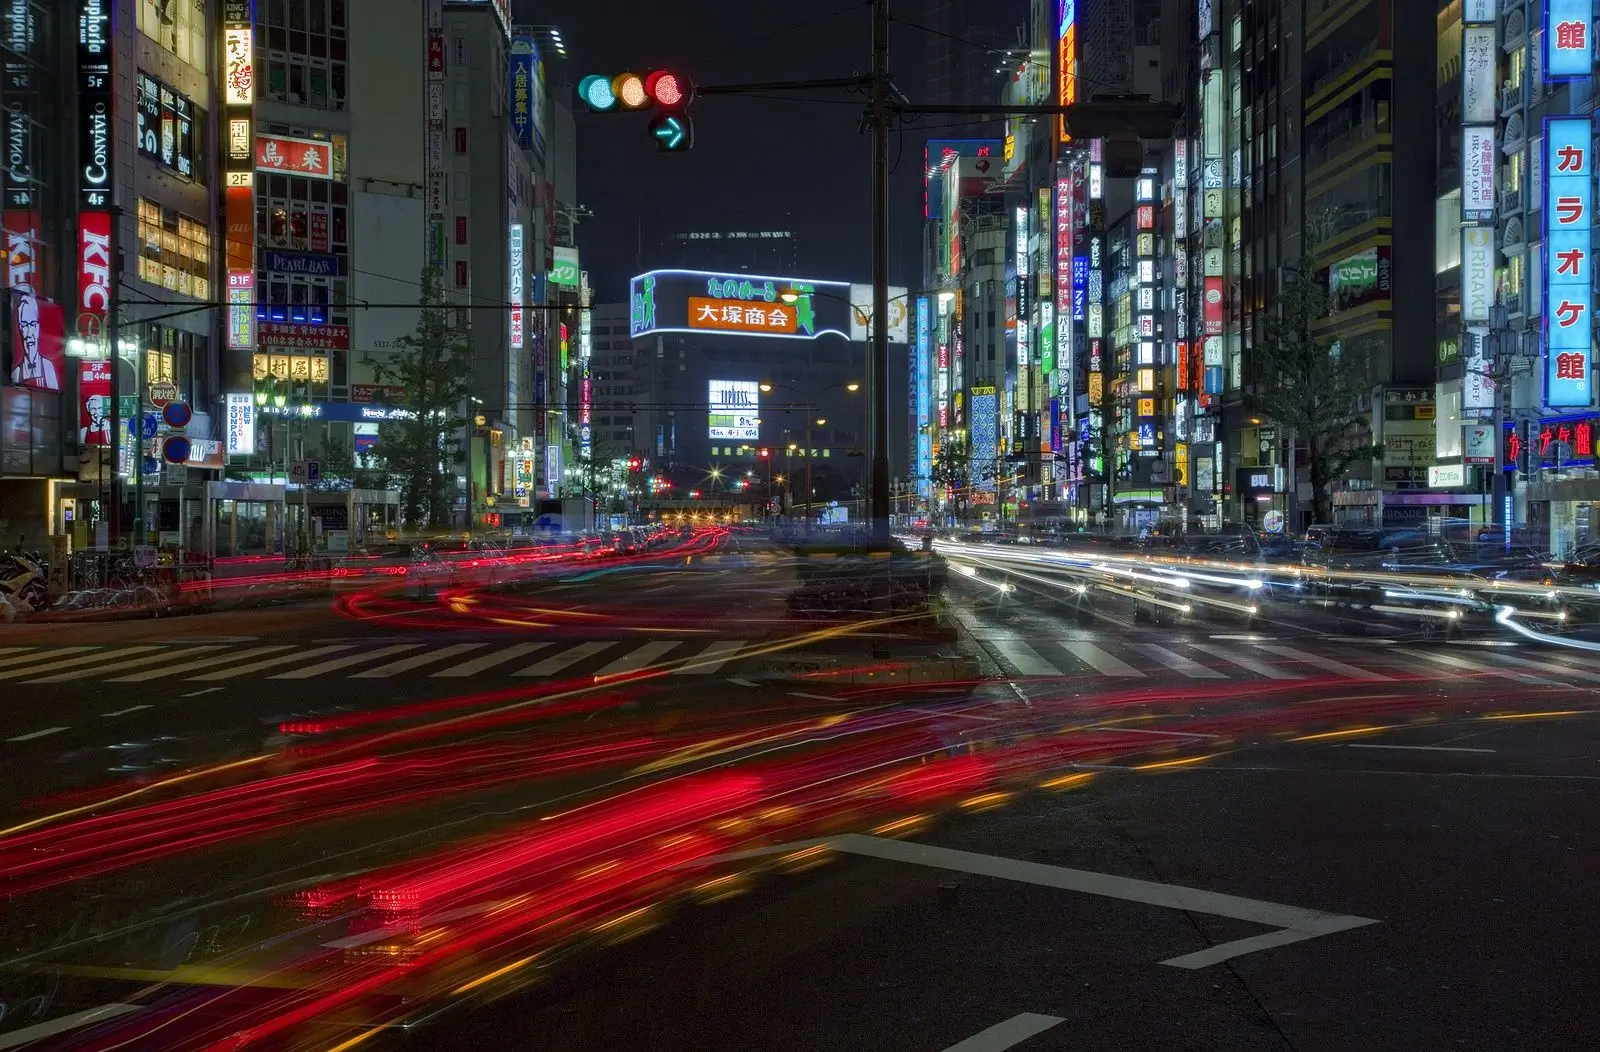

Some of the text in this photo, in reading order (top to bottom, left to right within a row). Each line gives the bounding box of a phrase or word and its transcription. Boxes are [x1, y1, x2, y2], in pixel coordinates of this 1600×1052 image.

[1556, 22, 1586, 49] 館
[88, 76, 103, 87] 5F
[232, 121, 248, 152] 和民
[1471, 134, 1480, 178] BRAND
[232, 174, 248, 185] 2F
[88, 193, 104, 205] 4F
[1058, 182, 1069, 232] カラオケ
[229, 222, 252, 233] au
[83, 229, 109, 311] KFC
[273, 254, 330, 273] PEARL BAR
[1058, 247, 1069, 284] パセラ
[1556, 145, 1586, 380] カラオケ館
[230, 276, 250, 285] B1F
[707, 278, 776, 302] たのめーる
[696, 304, 789, 327] 大塚商会
[92, 363, 103, 371] 2F
[152, 389, 175, 401] 消火栓
[243, 405, 251, 425] NEW
[229, 405, 238, 451] SUNPARK
[1508, 421, 1592, 462] カオケ館
